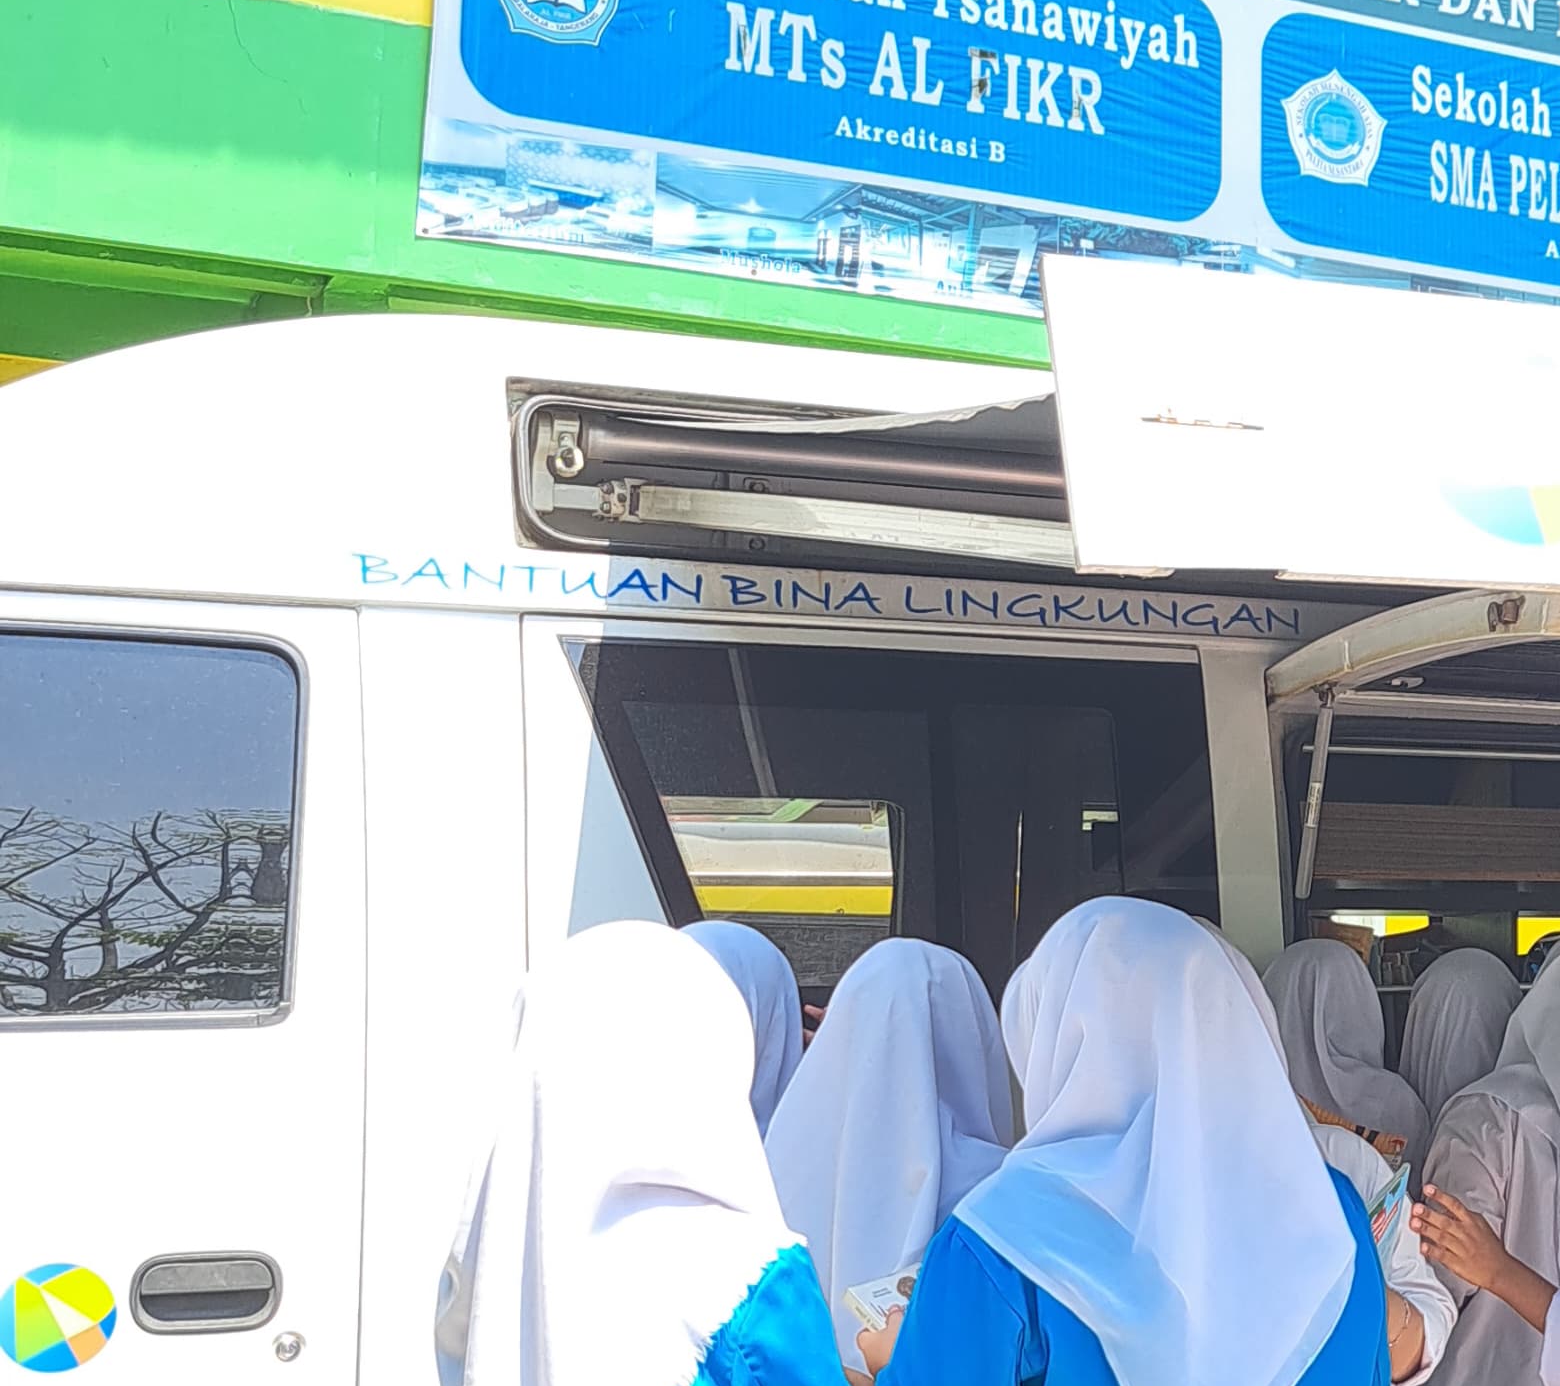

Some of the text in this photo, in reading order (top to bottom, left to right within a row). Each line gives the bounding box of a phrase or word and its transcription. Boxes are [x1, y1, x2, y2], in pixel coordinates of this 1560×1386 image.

[724, 1, 1105, 136] MTs AL FIKR
[1411, 64, 1552, 138] Sekolah
[835, 115, 1006, 164] Akreditasi B
[1429, 139, 1498, 213] SMA
[352, 552, 1301, 635] BANTUAN BINA LINGKUNGAN
